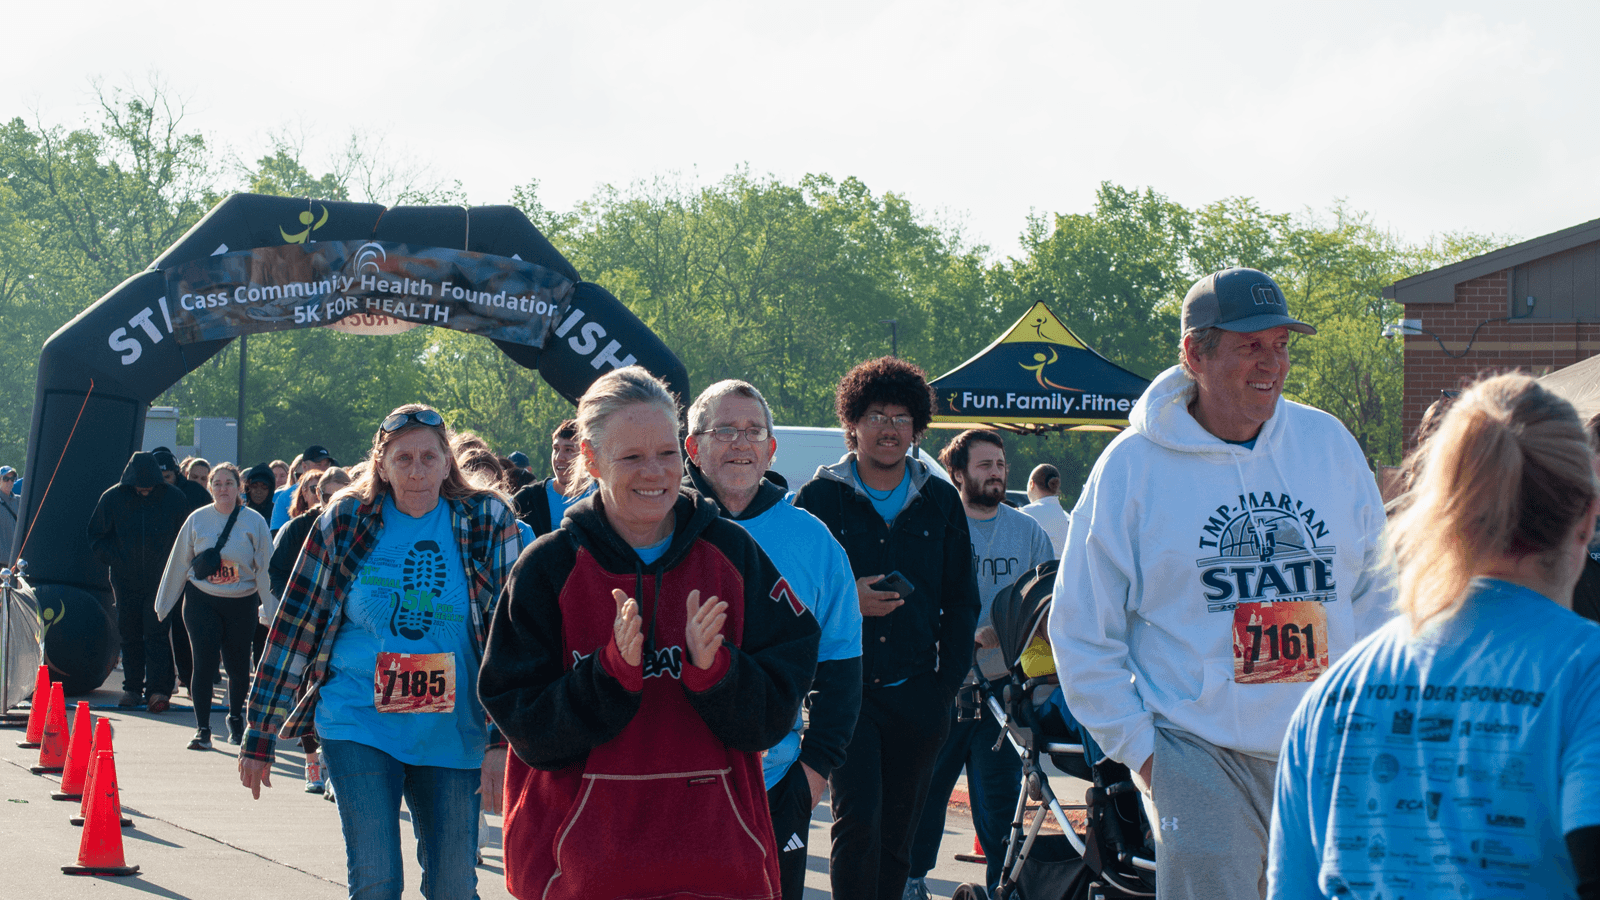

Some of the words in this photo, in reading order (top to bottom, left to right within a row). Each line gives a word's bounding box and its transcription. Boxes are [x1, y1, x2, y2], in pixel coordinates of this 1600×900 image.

[180, 291, 228, 311] Cass
[360, 274, 433, 296] Health
[294, 304, 321, 324] 5K
[326, 296, 358, 320] FOR
[366, 297, 449, 323] HEALTH
[1200, 557, 1336, 602] STATE
[402, 589, 437, 613] 5K
[436, 603, 454, 613] FOR
[769, 576, 806, 617] 7
[1245, 623, 1315, 662] 7161
[383, 669, 446, 697] 7185
[1366, 684, 1399, 701] YOU
